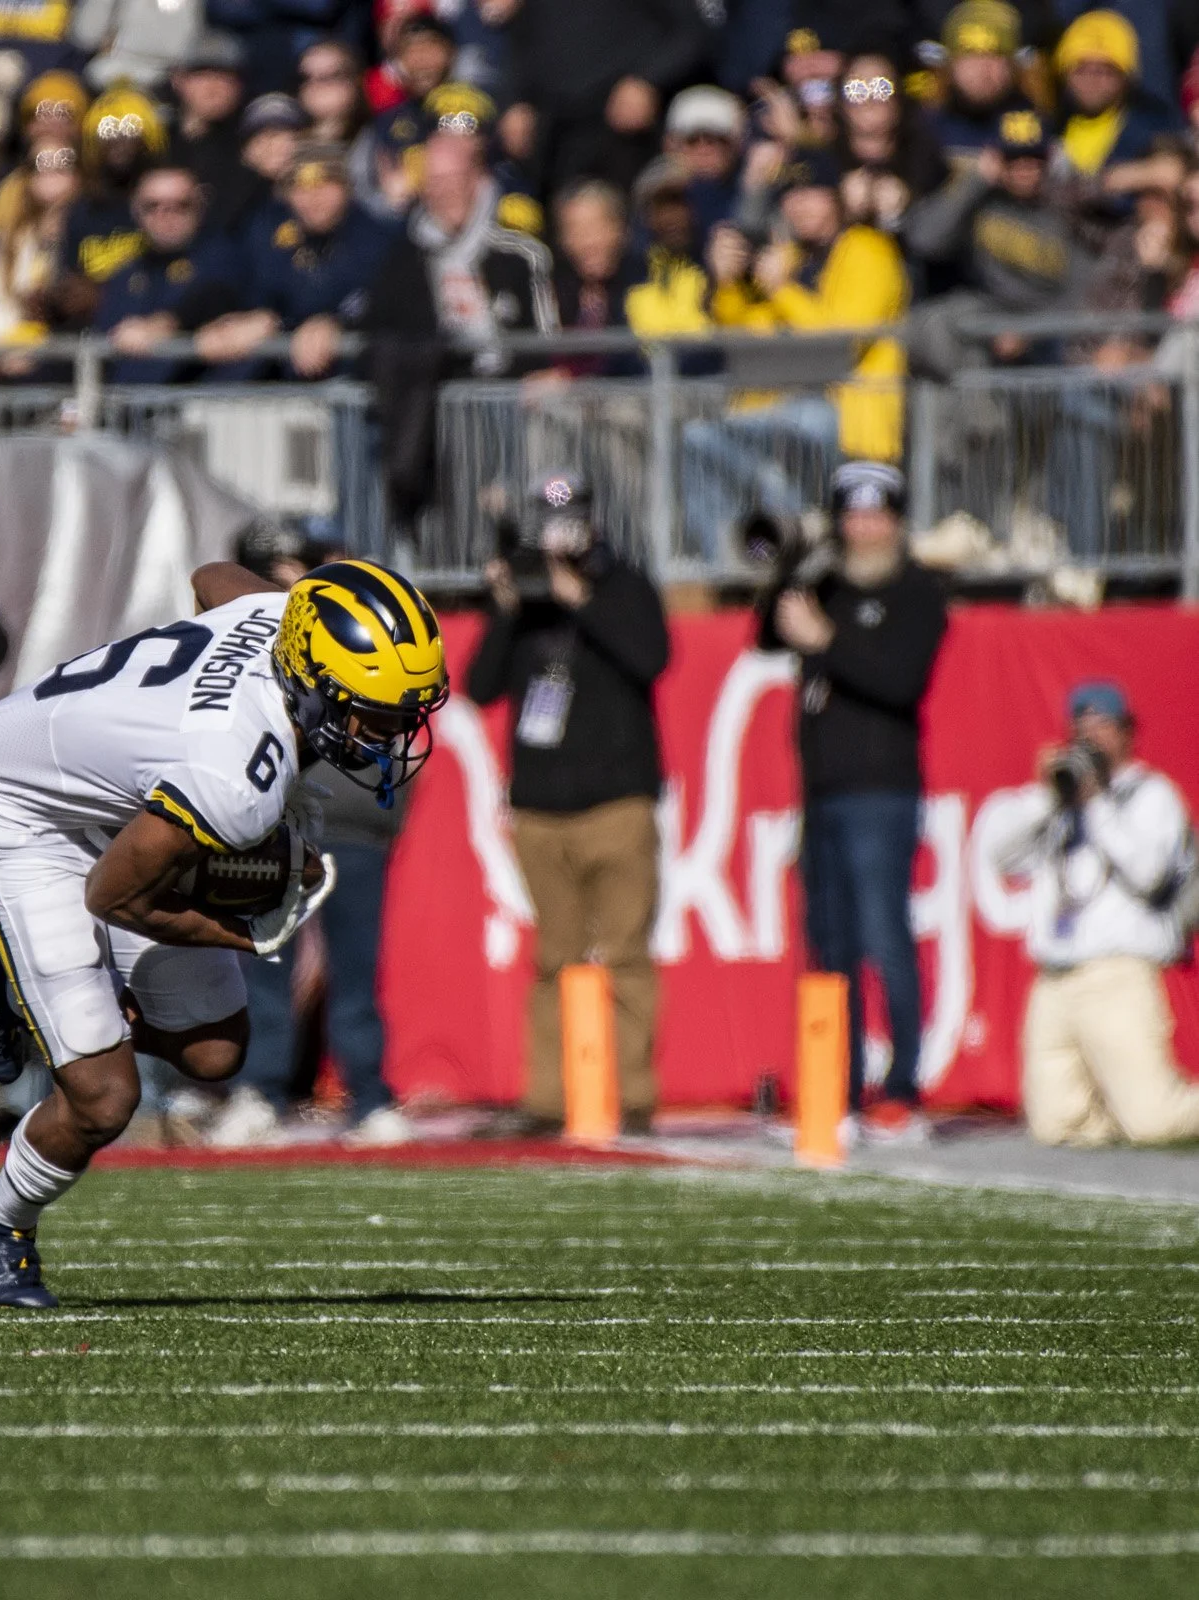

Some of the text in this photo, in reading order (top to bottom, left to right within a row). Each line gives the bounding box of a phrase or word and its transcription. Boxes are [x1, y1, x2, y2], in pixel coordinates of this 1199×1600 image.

[33, 620, 215, 701] 6
[189, 608, 281, 712] JOHNSON
[245, 730, 285, 794] 6
